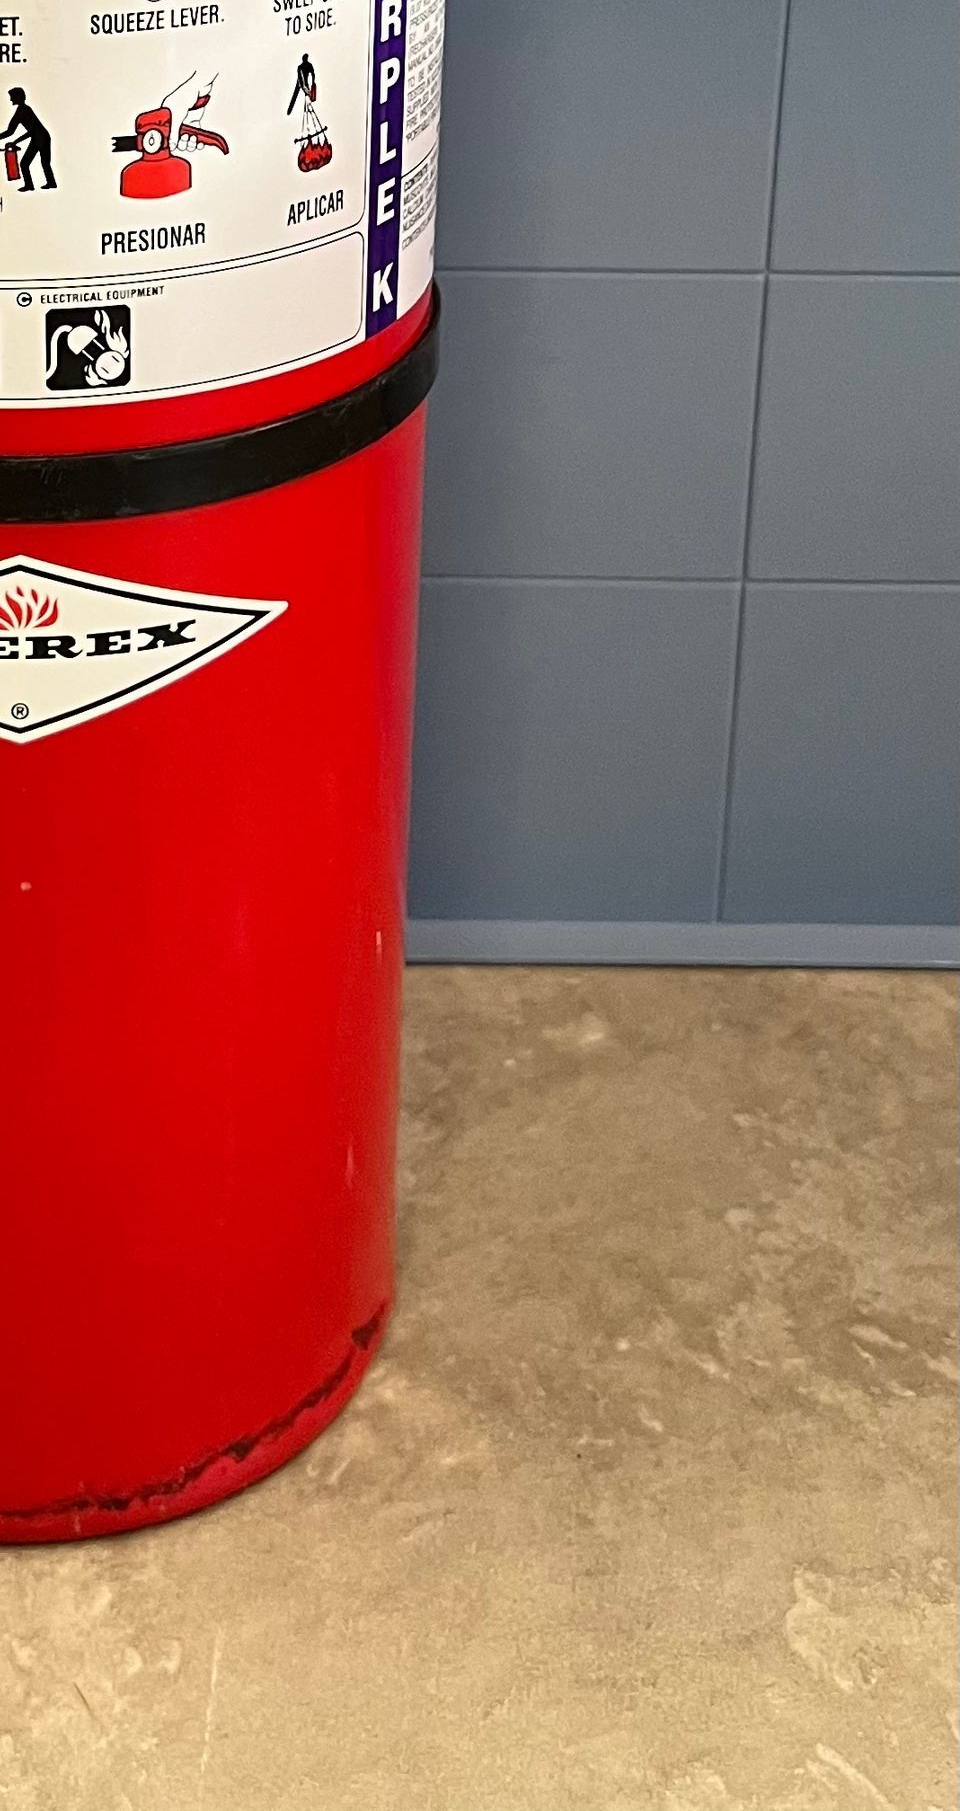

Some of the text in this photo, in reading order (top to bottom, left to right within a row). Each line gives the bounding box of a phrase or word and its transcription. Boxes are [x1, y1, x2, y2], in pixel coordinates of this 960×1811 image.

[90, 5, 225, 35] SQUEEZE LEVER.
[284, 8, 337, 36] TO SIDE.
[286, 190, 344, 226] APLICAR
[100, 222, 207, 256] PRESIONAR
[39, 290, 103, 306] ELECTRICAL
[106, 285, 165, 302] EQUIPMENT
[371, 269, 396, 312] K
